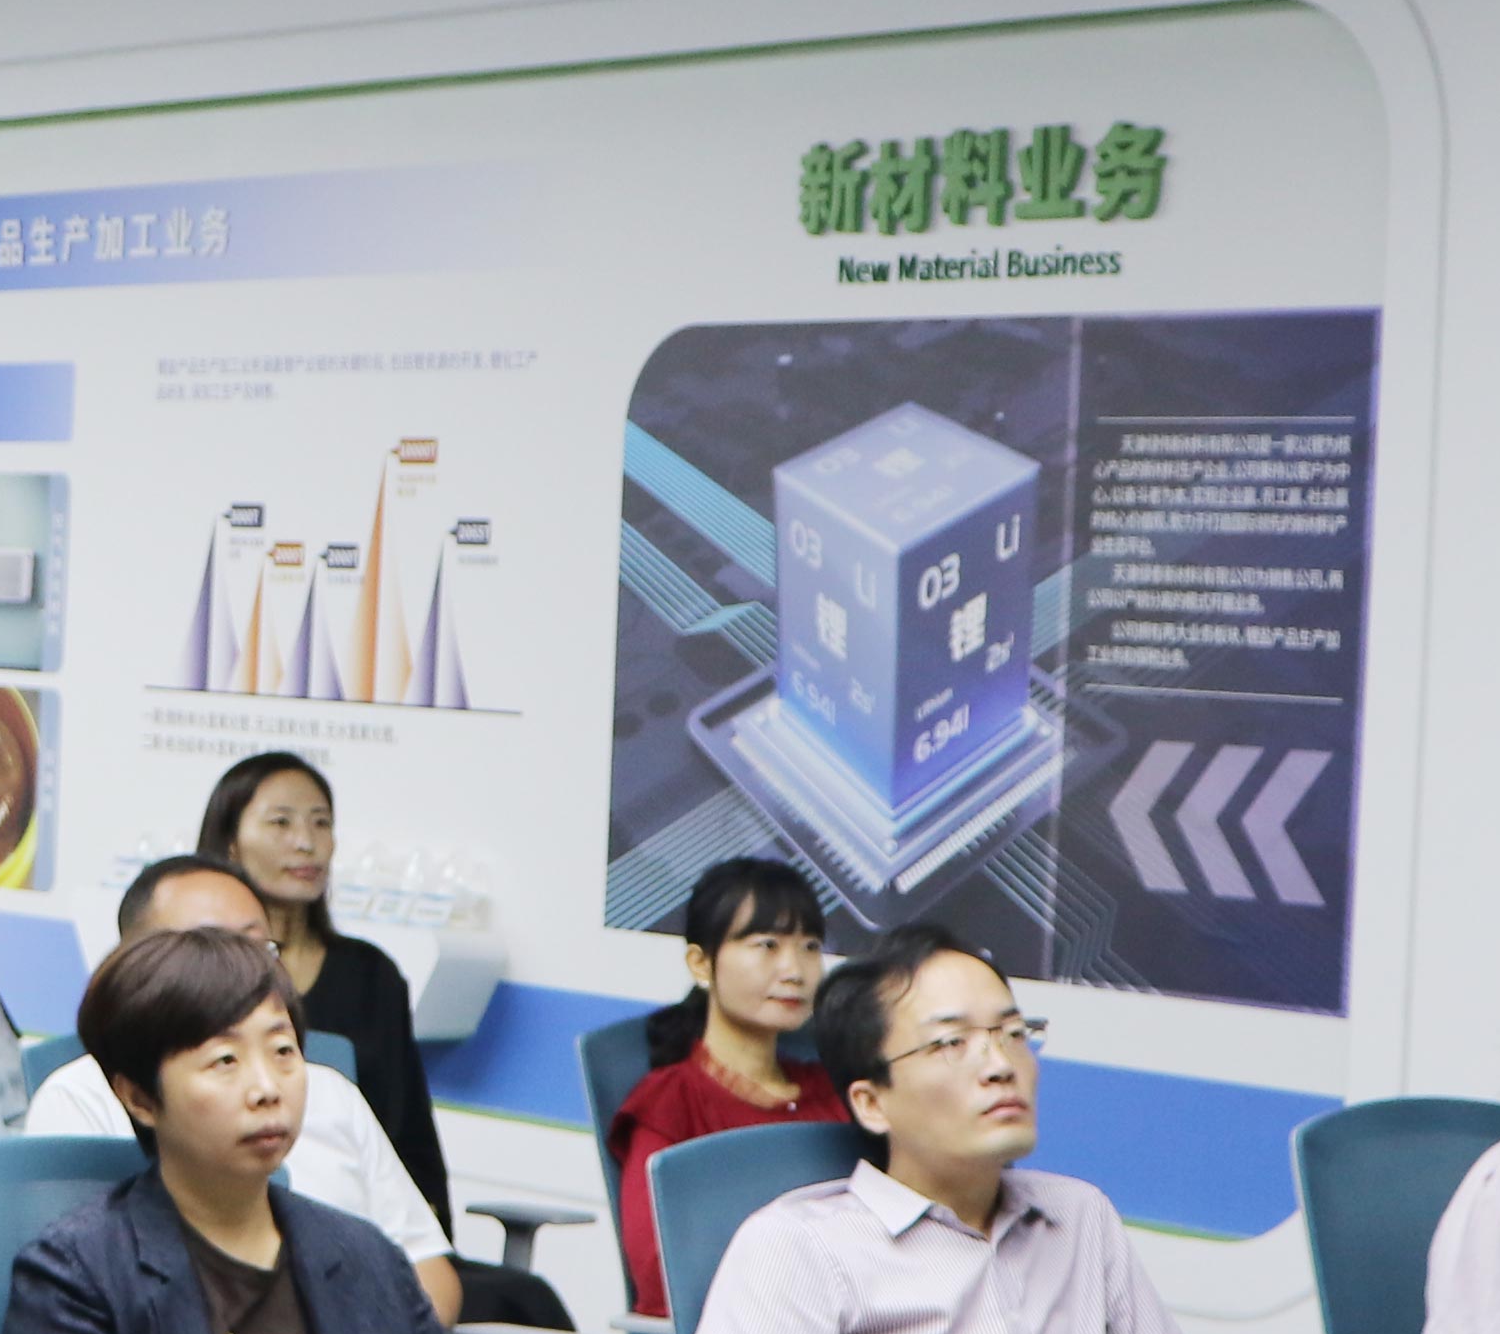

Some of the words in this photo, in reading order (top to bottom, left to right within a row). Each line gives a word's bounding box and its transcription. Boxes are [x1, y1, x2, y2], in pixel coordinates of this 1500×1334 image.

[799, 120, 1168, 235] 新材料业务
[838, 254, 891, 284] New
[898, 248, 999, 282] Material
[1006, 244, 1123, 278] Business
[917, 552, 961, 610] 03
